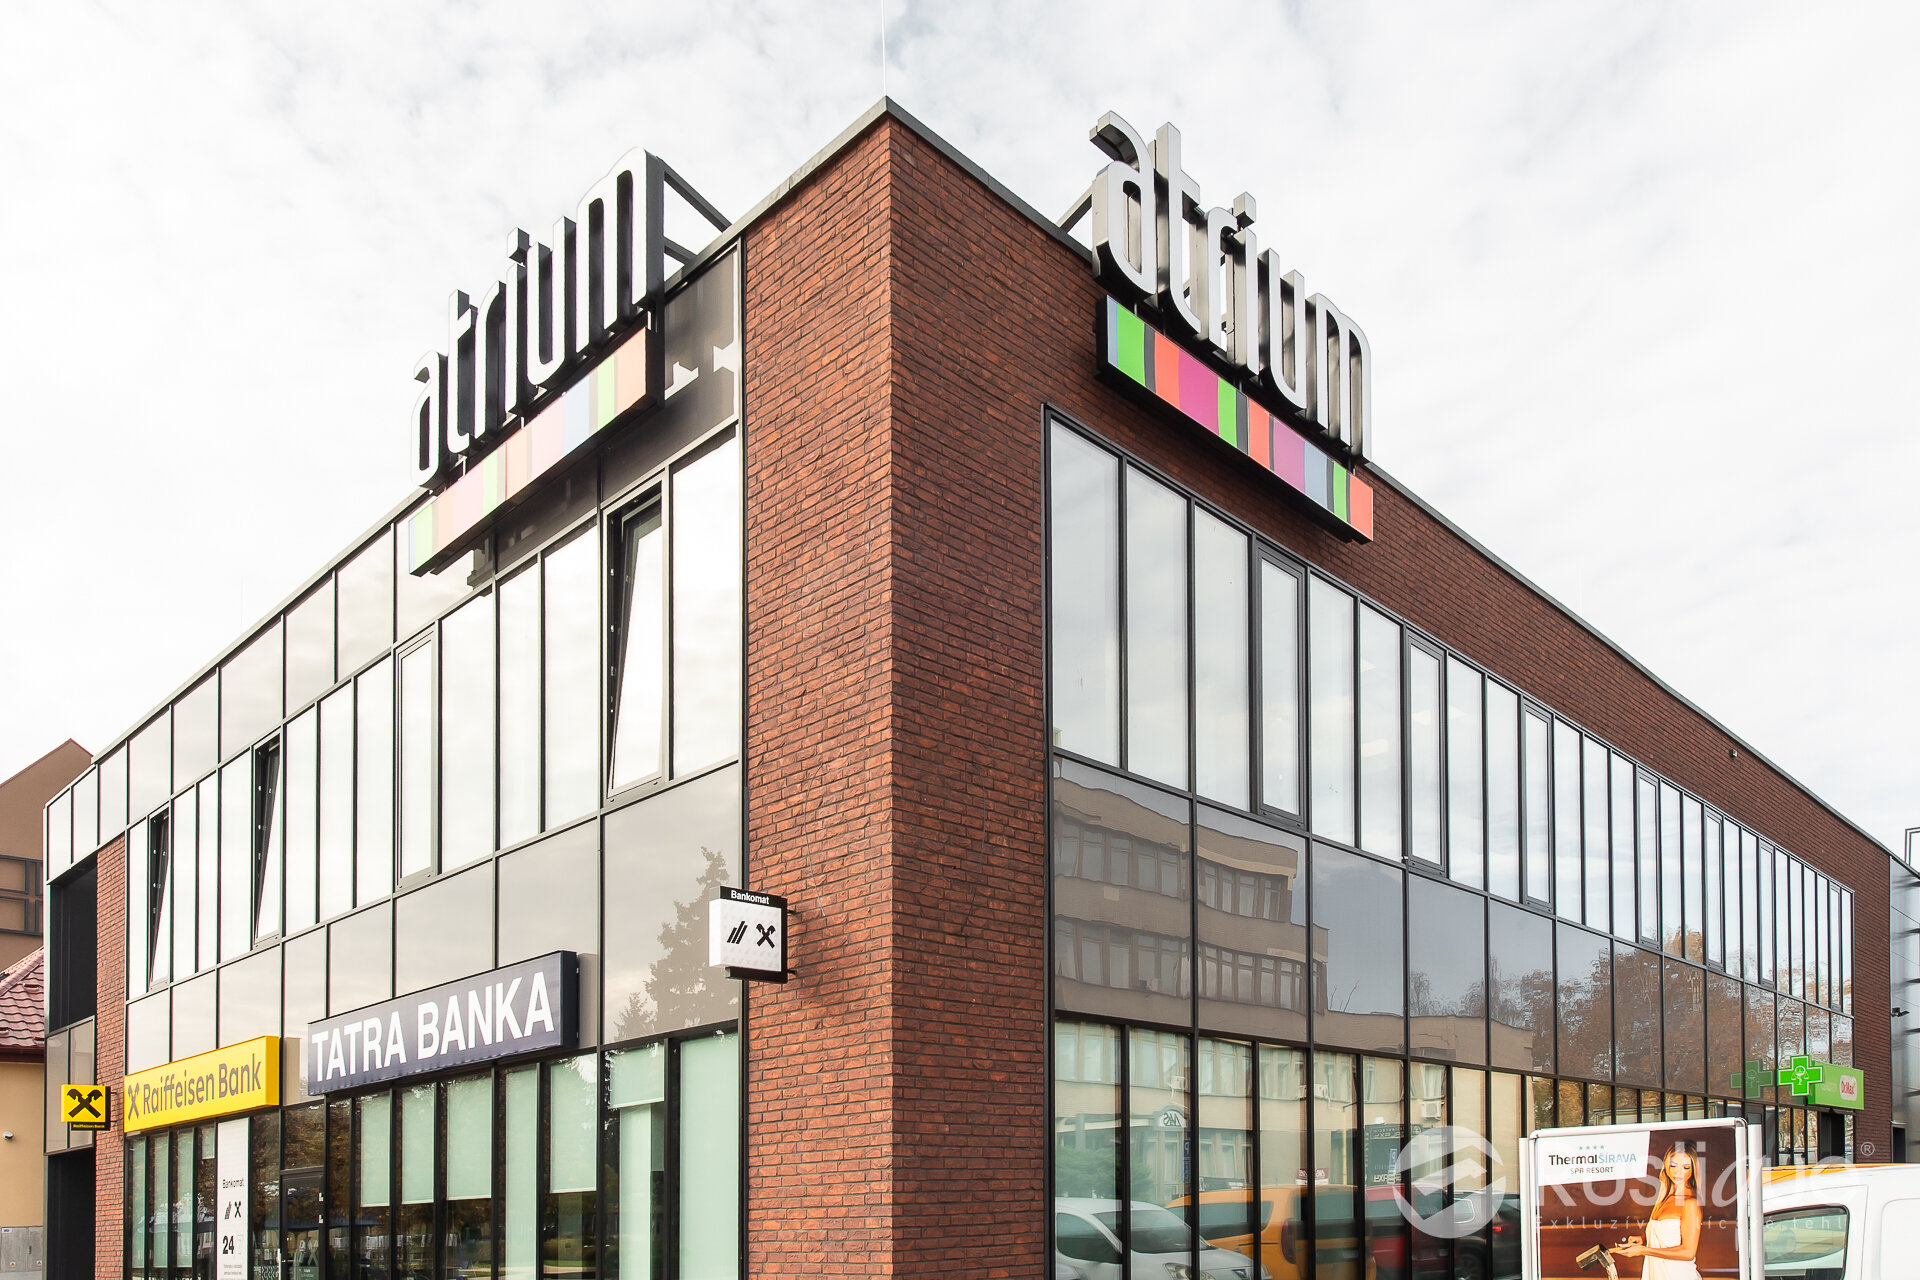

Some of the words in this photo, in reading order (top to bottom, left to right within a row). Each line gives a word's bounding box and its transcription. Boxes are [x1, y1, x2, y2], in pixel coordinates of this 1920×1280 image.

[411, 146, 652, 486] atrium
[1090, 110, 1371, 462] atrium
[730, 890, 770, 905] Bankomat
[311, 1010, 407, 1083] TATRA
[417, 971, 555, 1060] BANKA
[143, 1069, 215, 1116] Raiffeisen
[218, 1053, 262, 1098] Bank
[1586, 1166, 1614, 1174] RESORT
[222, 1235, 234, 1255] 24
